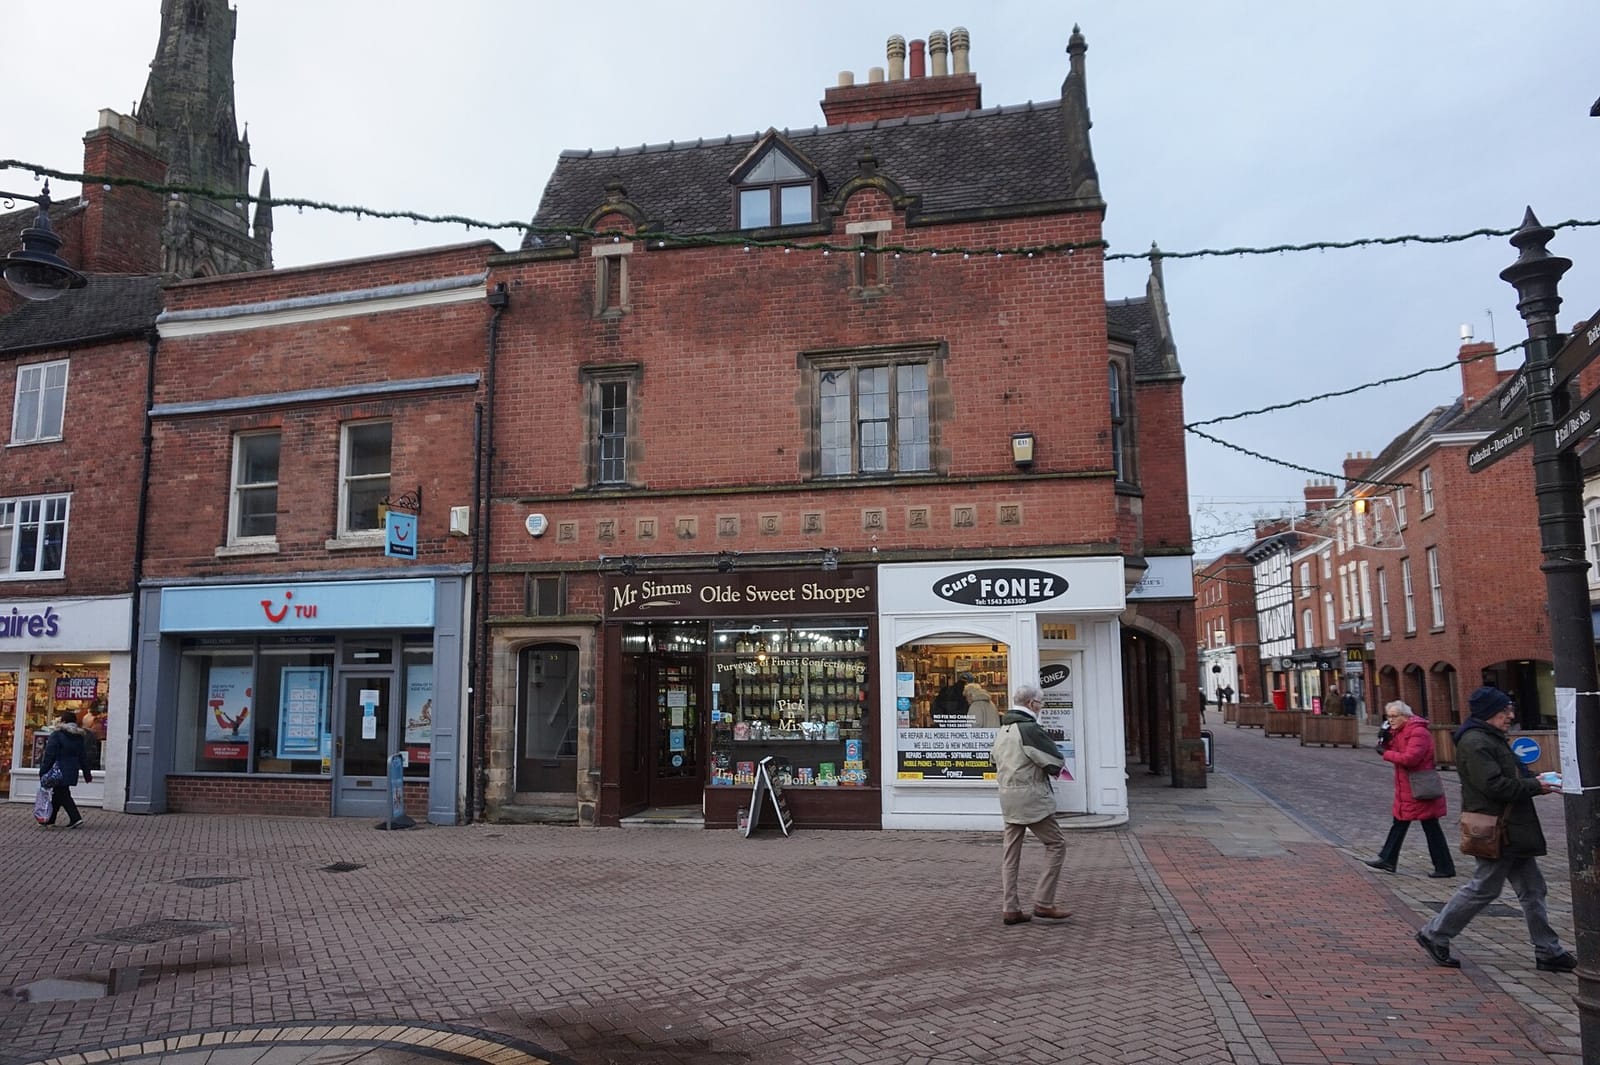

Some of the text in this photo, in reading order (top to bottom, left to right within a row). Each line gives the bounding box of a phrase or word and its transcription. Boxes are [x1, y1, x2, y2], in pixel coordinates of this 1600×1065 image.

[941, 573, 1055, 598] Cure FONEZ
[613, 584, 638, 612] Mr
[641, 581, 692, 599] Simms
[700, 585, 741, 603] Olde
[745, 584, 796, 602] Sweet
[1003, 597, 1027, 605] 263300
[295, 605, 317, 618] TUI
[717, 660, 757, 673] Purveyor
[772, 657, 799, 667] Finest
[802, 657, 866, 673] Confectionery
[70, 686, 95, 699] FREE
[777, 699, 805, 712] Pick
[900, 732, 907, 740] WE
